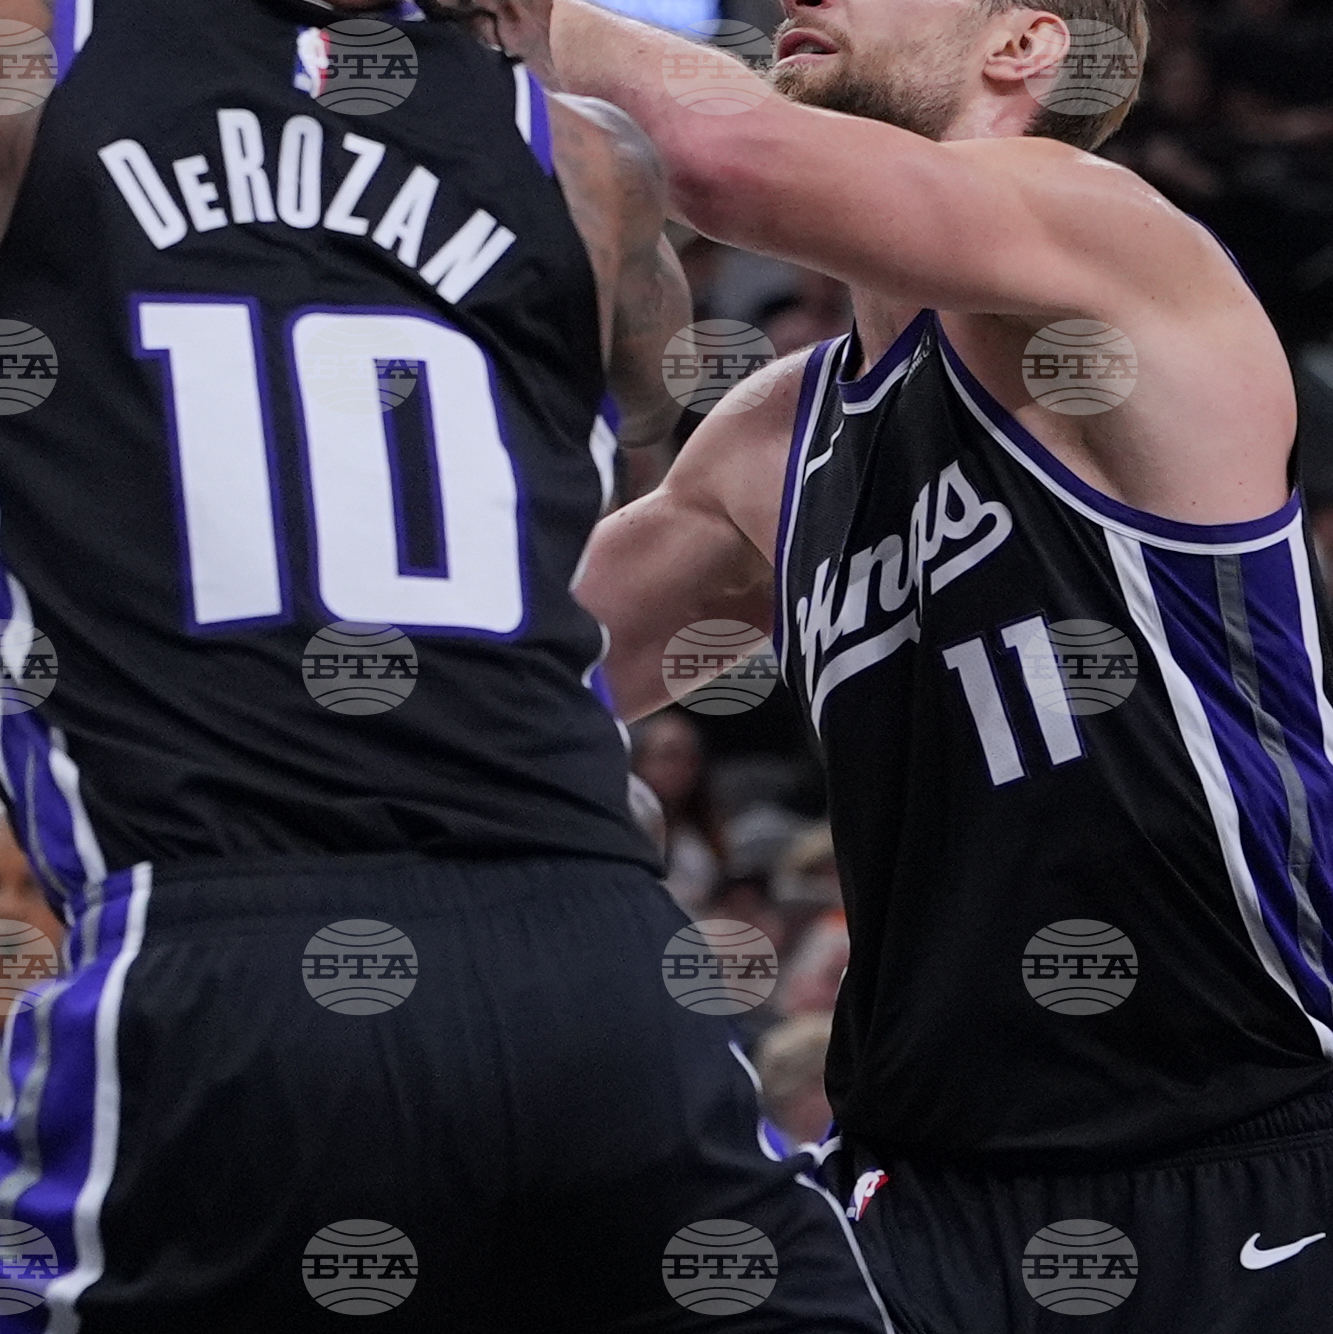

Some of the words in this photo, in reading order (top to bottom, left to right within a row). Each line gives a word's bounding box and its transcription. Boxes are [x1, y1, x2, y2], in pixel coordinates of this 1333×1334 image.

[97, 107, 518, 305] DeROZAN
[130, 294, 526, 637] 10
[941, 614, 1085, 787] 11
